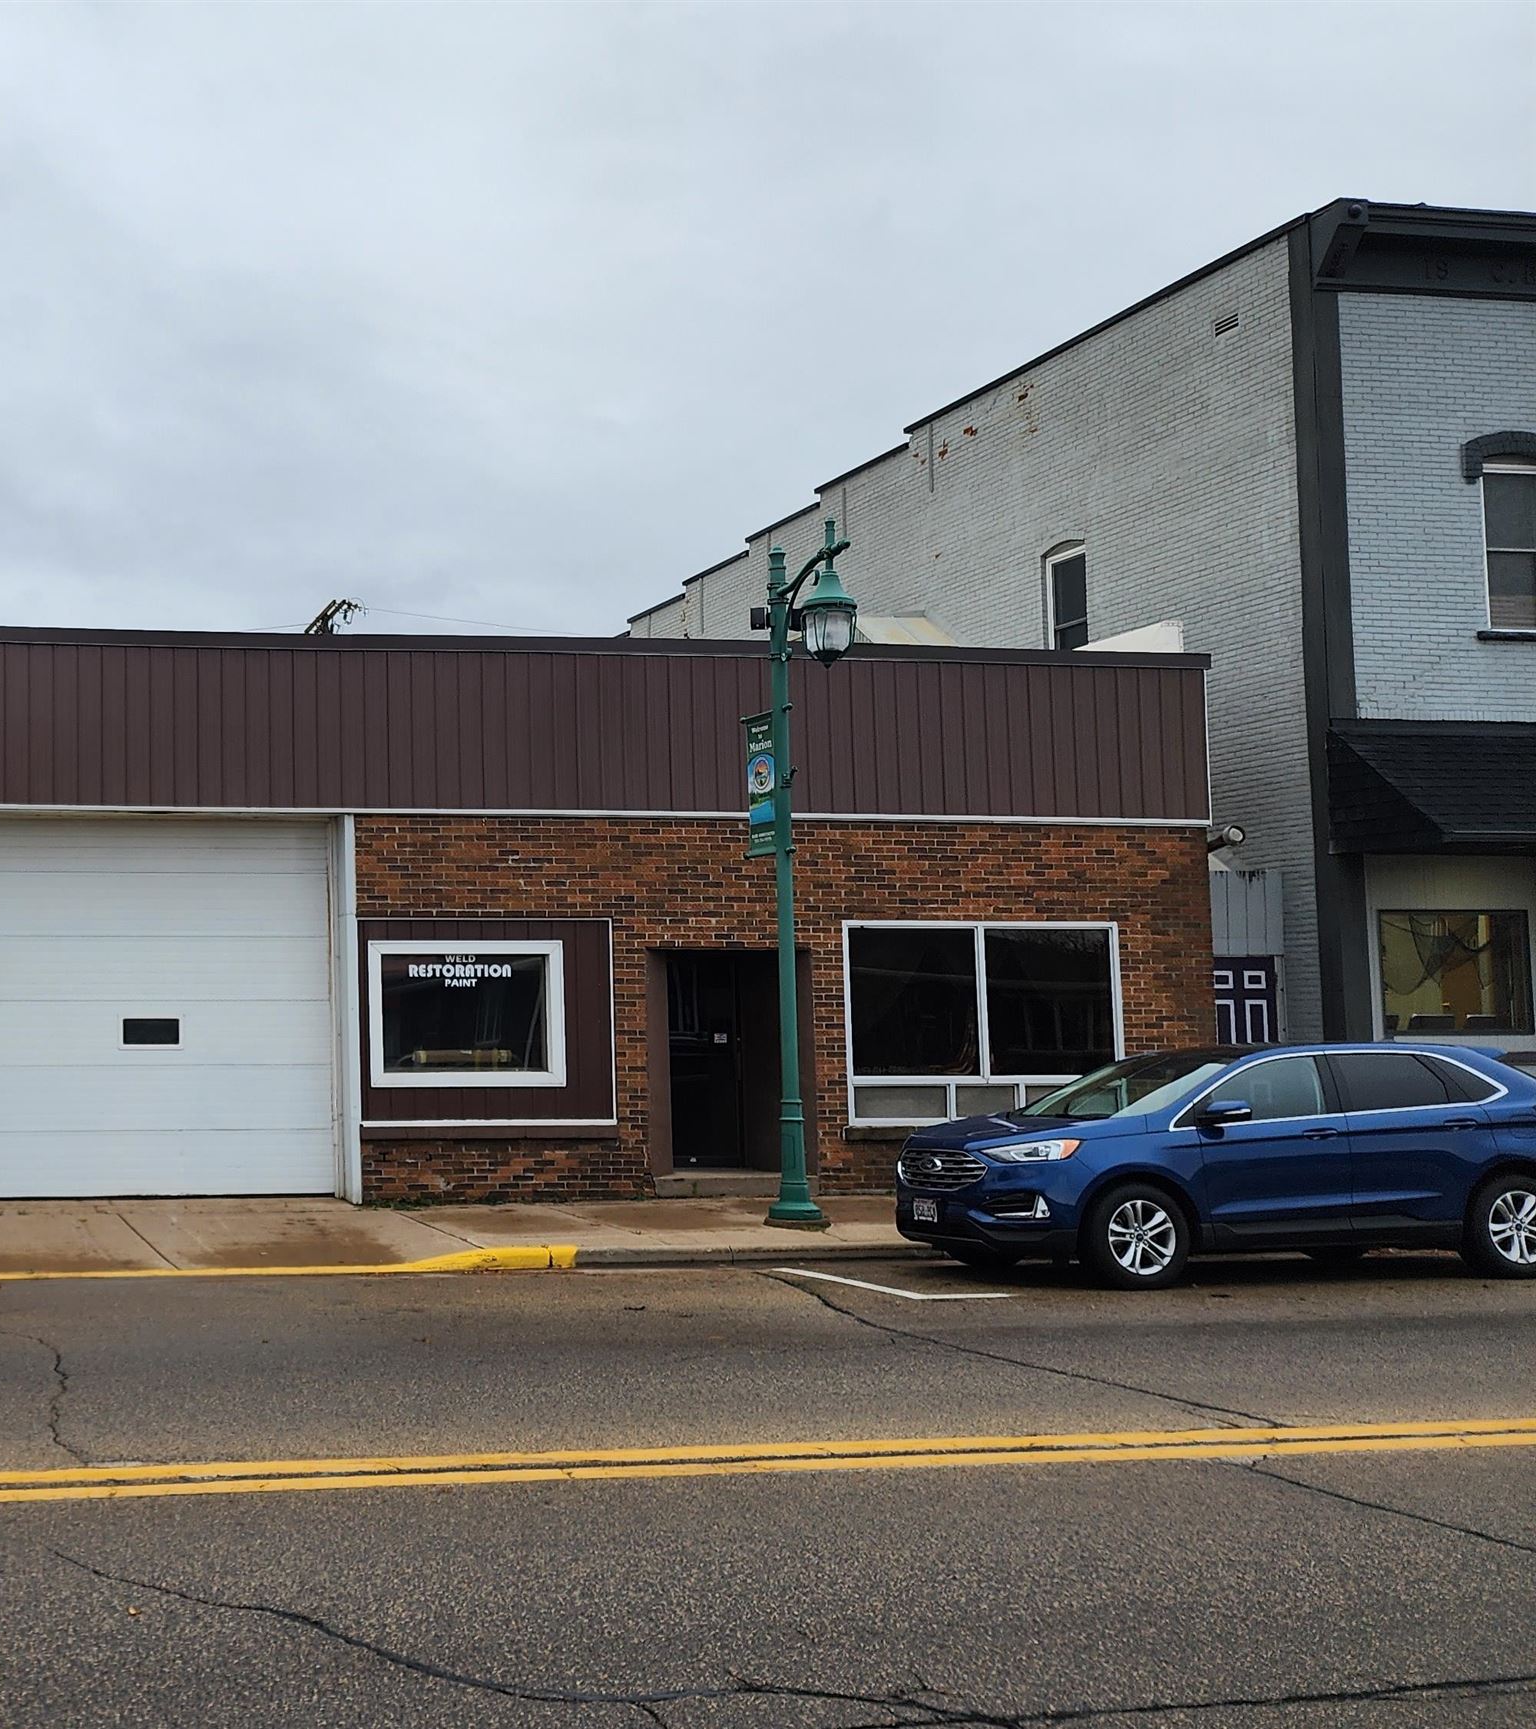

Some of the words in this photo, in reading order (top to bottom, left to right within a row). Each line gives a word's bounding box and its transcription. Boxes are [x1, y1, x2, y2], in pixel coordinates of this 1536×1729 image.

[749, 739, 773, 753] Marion
[445, 955, 476, 963] WELD
[408, 964, 512, 978] RESTORATION
[444, 979, 477, 988] PAINT
